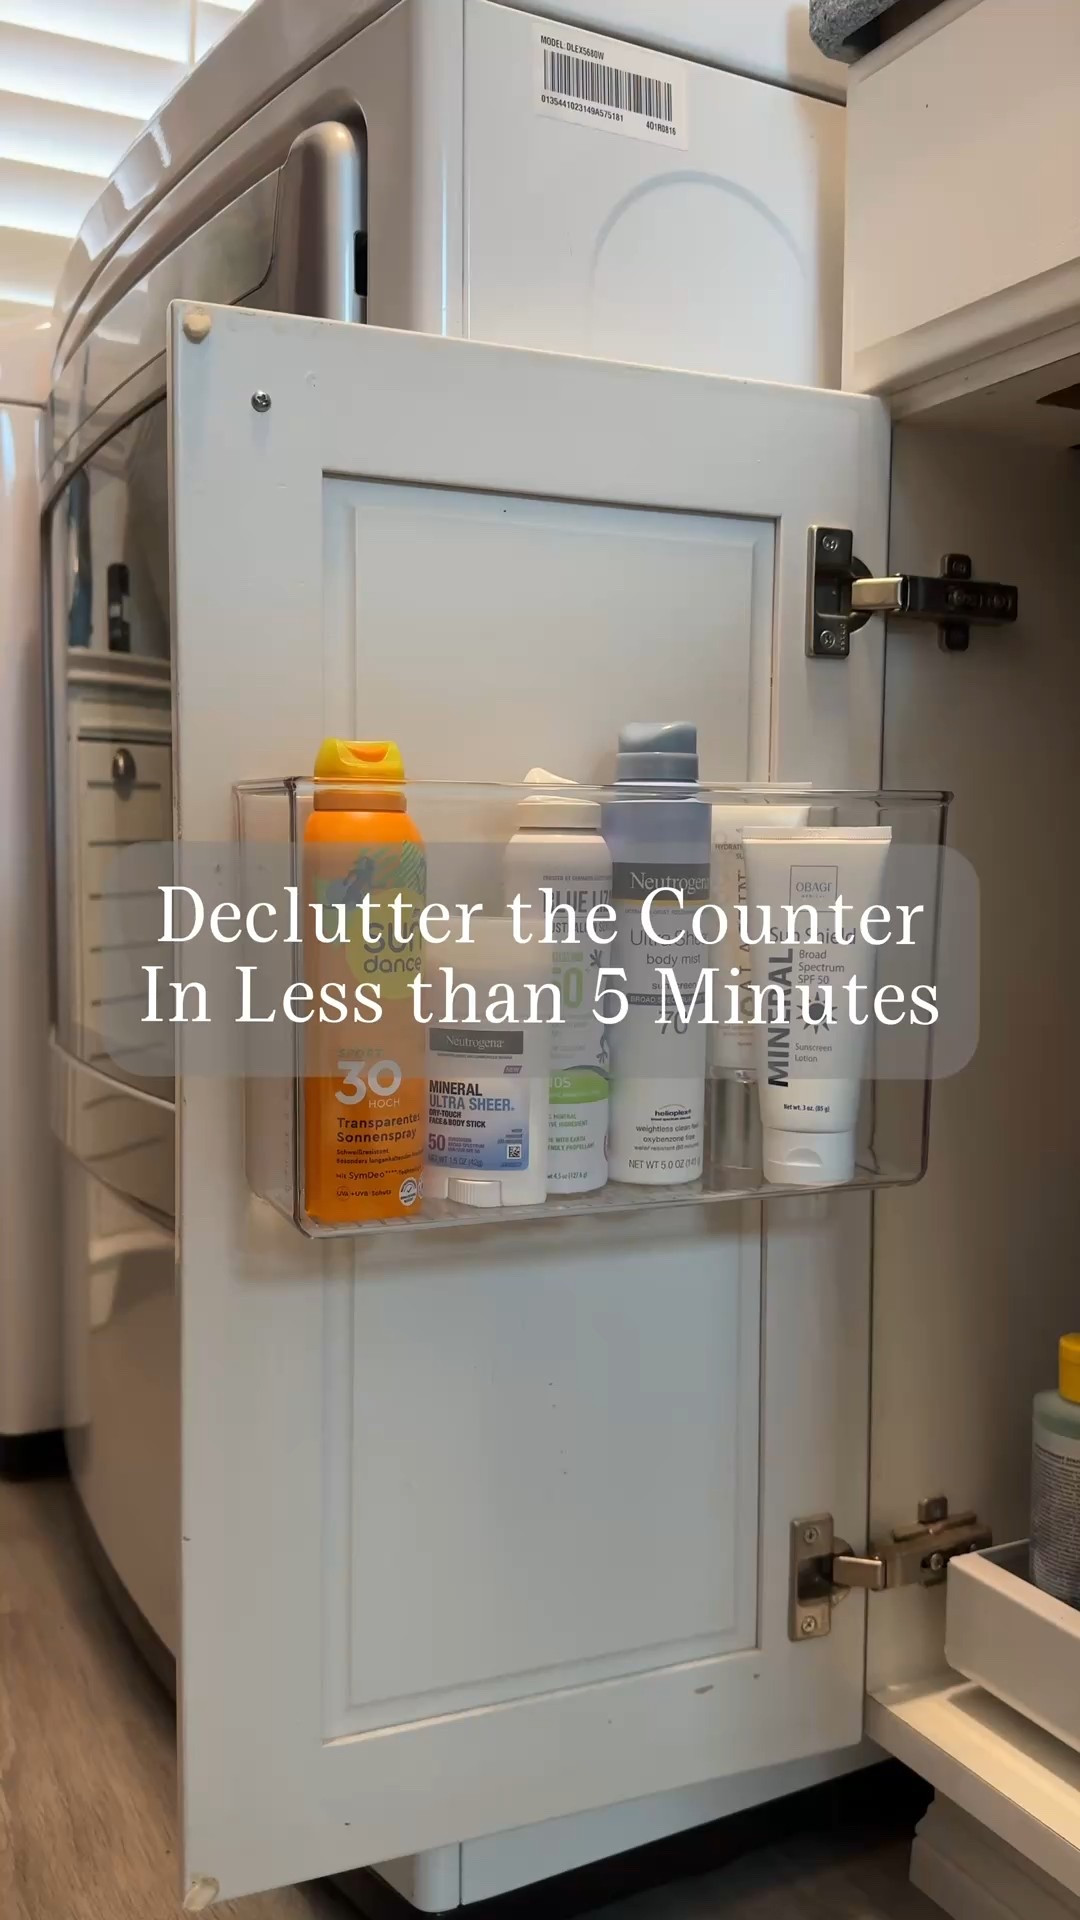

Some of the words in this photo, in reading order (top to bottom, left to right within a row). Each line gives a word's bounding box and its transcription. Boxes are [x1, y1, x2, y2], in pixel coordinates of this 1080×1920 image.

[566, 42, 604, 60] DLEX5680W
[630, 872, 709, 894] Neutrogen
[795, 882, 832, 892] OBAGI
[593, 890, 612, 912] LIZ
[646, 953, 678, 968] body
[681, 954, 701, 964] mist
[799, 949, 827, 959] Broad
[363, 955, 422, 973] dance
[798, 962, 845, 974] Spectrum
[797, 974, 816, 984] SPF
[817, 976, 830, 985] 50
[659, 1010, 688, 1034] 70
[768, 948, 794, 1088] MINERAL
[446, 1034, 504, 1050] Neutrogena
[795, 1042, 833, 1052] Sunscreen
[795, 1054, 818, 1063] Lotion
[335, 1059, 402, 1105] 30
[429, 1080, 483, 1097] MINERAL
[368, 1098, 400, 1109] HOCH
[429, 1094, 465, 1110] ULTRA
[429, 1108, 462, 1119] DRY-TOUCH
[466, 1119, 486, 1129] STICK
[636, 1124, 674, 1134] weightless
[336, 1128, 417, 1144] Sonnenspray
[428, 1133, 446, 1151] 50
[643, 1135, 684, 1144] oxybenzone
[628, 1159, 644, 1169] NET
[646, 1160, 659, 1169] WT
[675, 1159, 685, 1168] OZ
